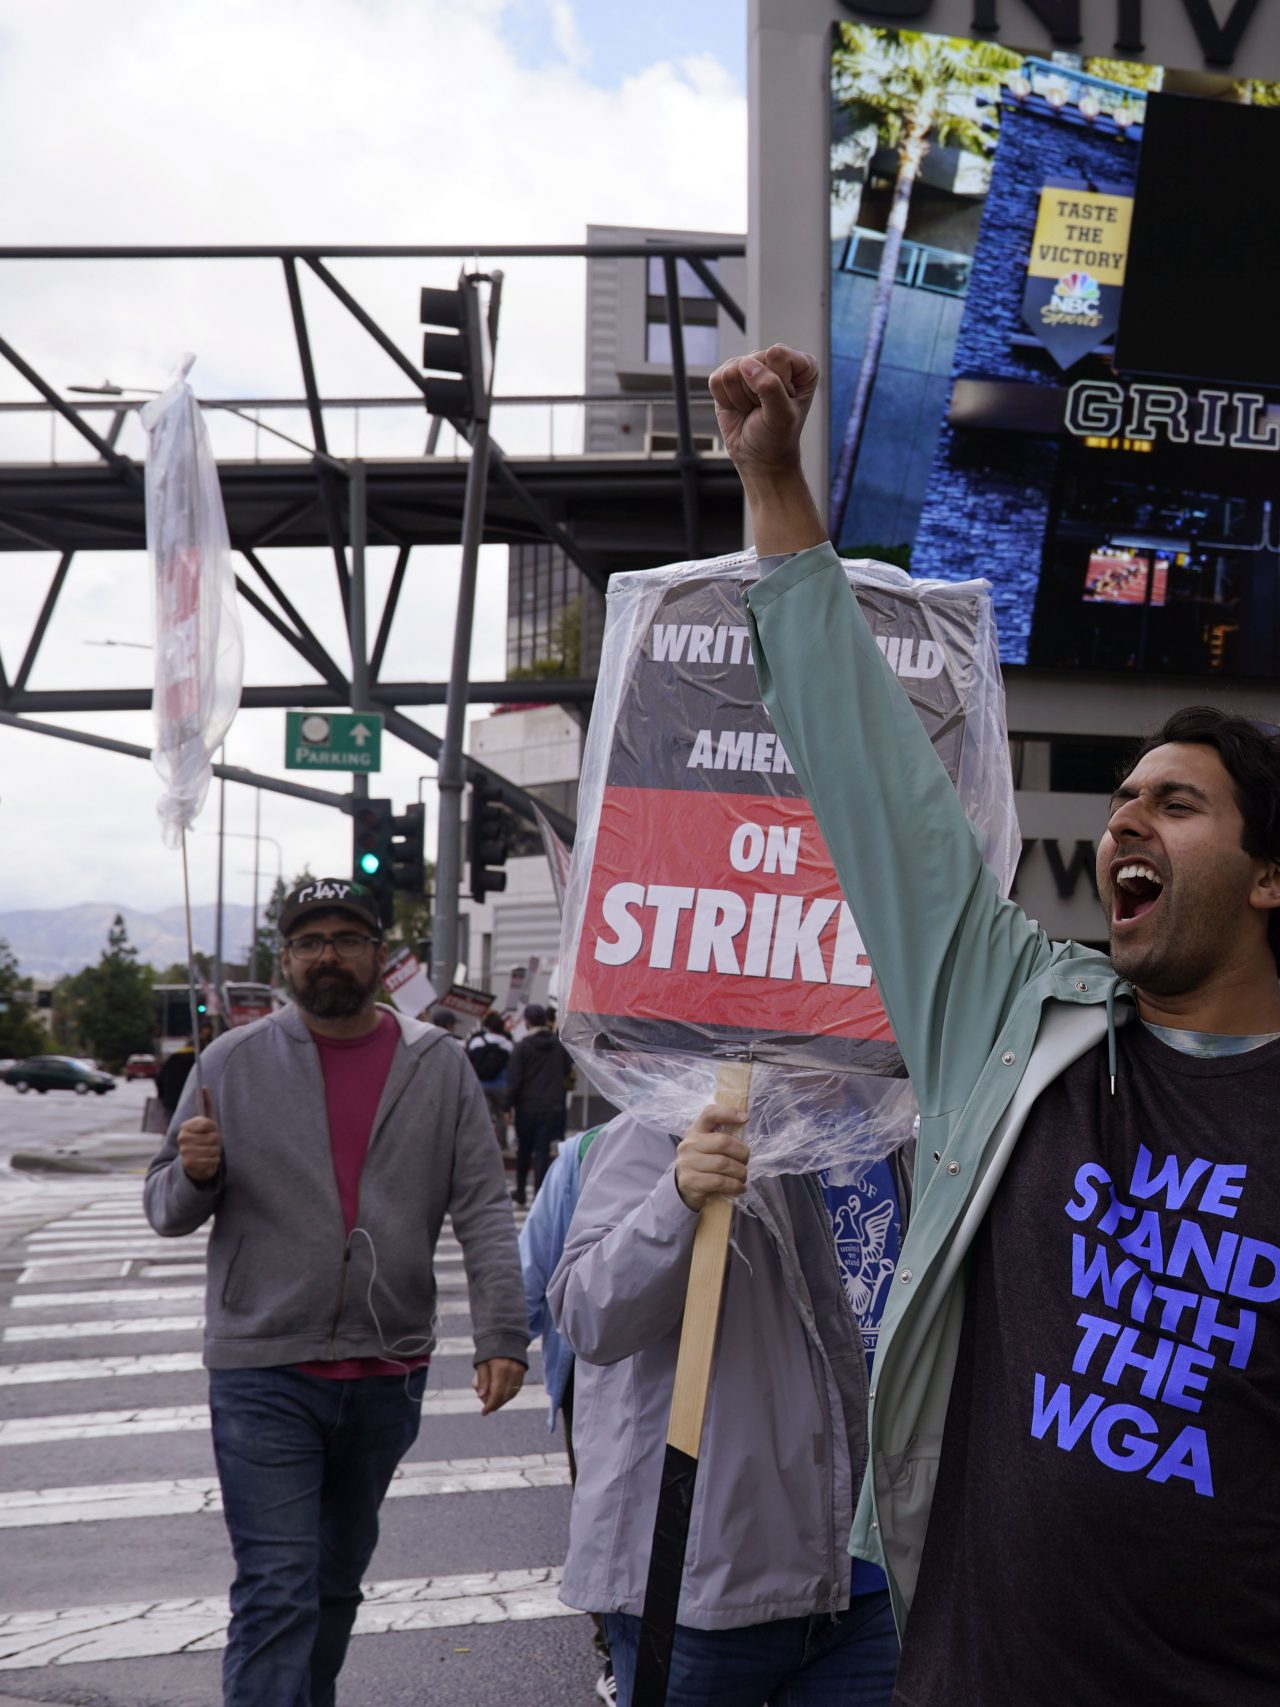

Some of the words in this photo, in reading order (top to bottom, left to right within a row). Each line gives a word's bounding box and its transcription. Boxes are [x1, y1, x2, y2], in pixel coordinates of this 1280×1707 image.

[1057, 201, 1119, 223] TASTE
[1065, 224, 1104, 244] THE
[1038, 245, 1125, 270] VICTORY
[1050, 294, 1100, 315] NBC
[652, 624, 755, 666] WRIT
[729, 823, 802, 875] ON
[1129, 1142, 1248, 1219] WE
[1071, 1233, 1257, 1370] WITH
[1071, 1312, 1216, 1414] THE
[1030, 1372, 1215, 1498] WGA
